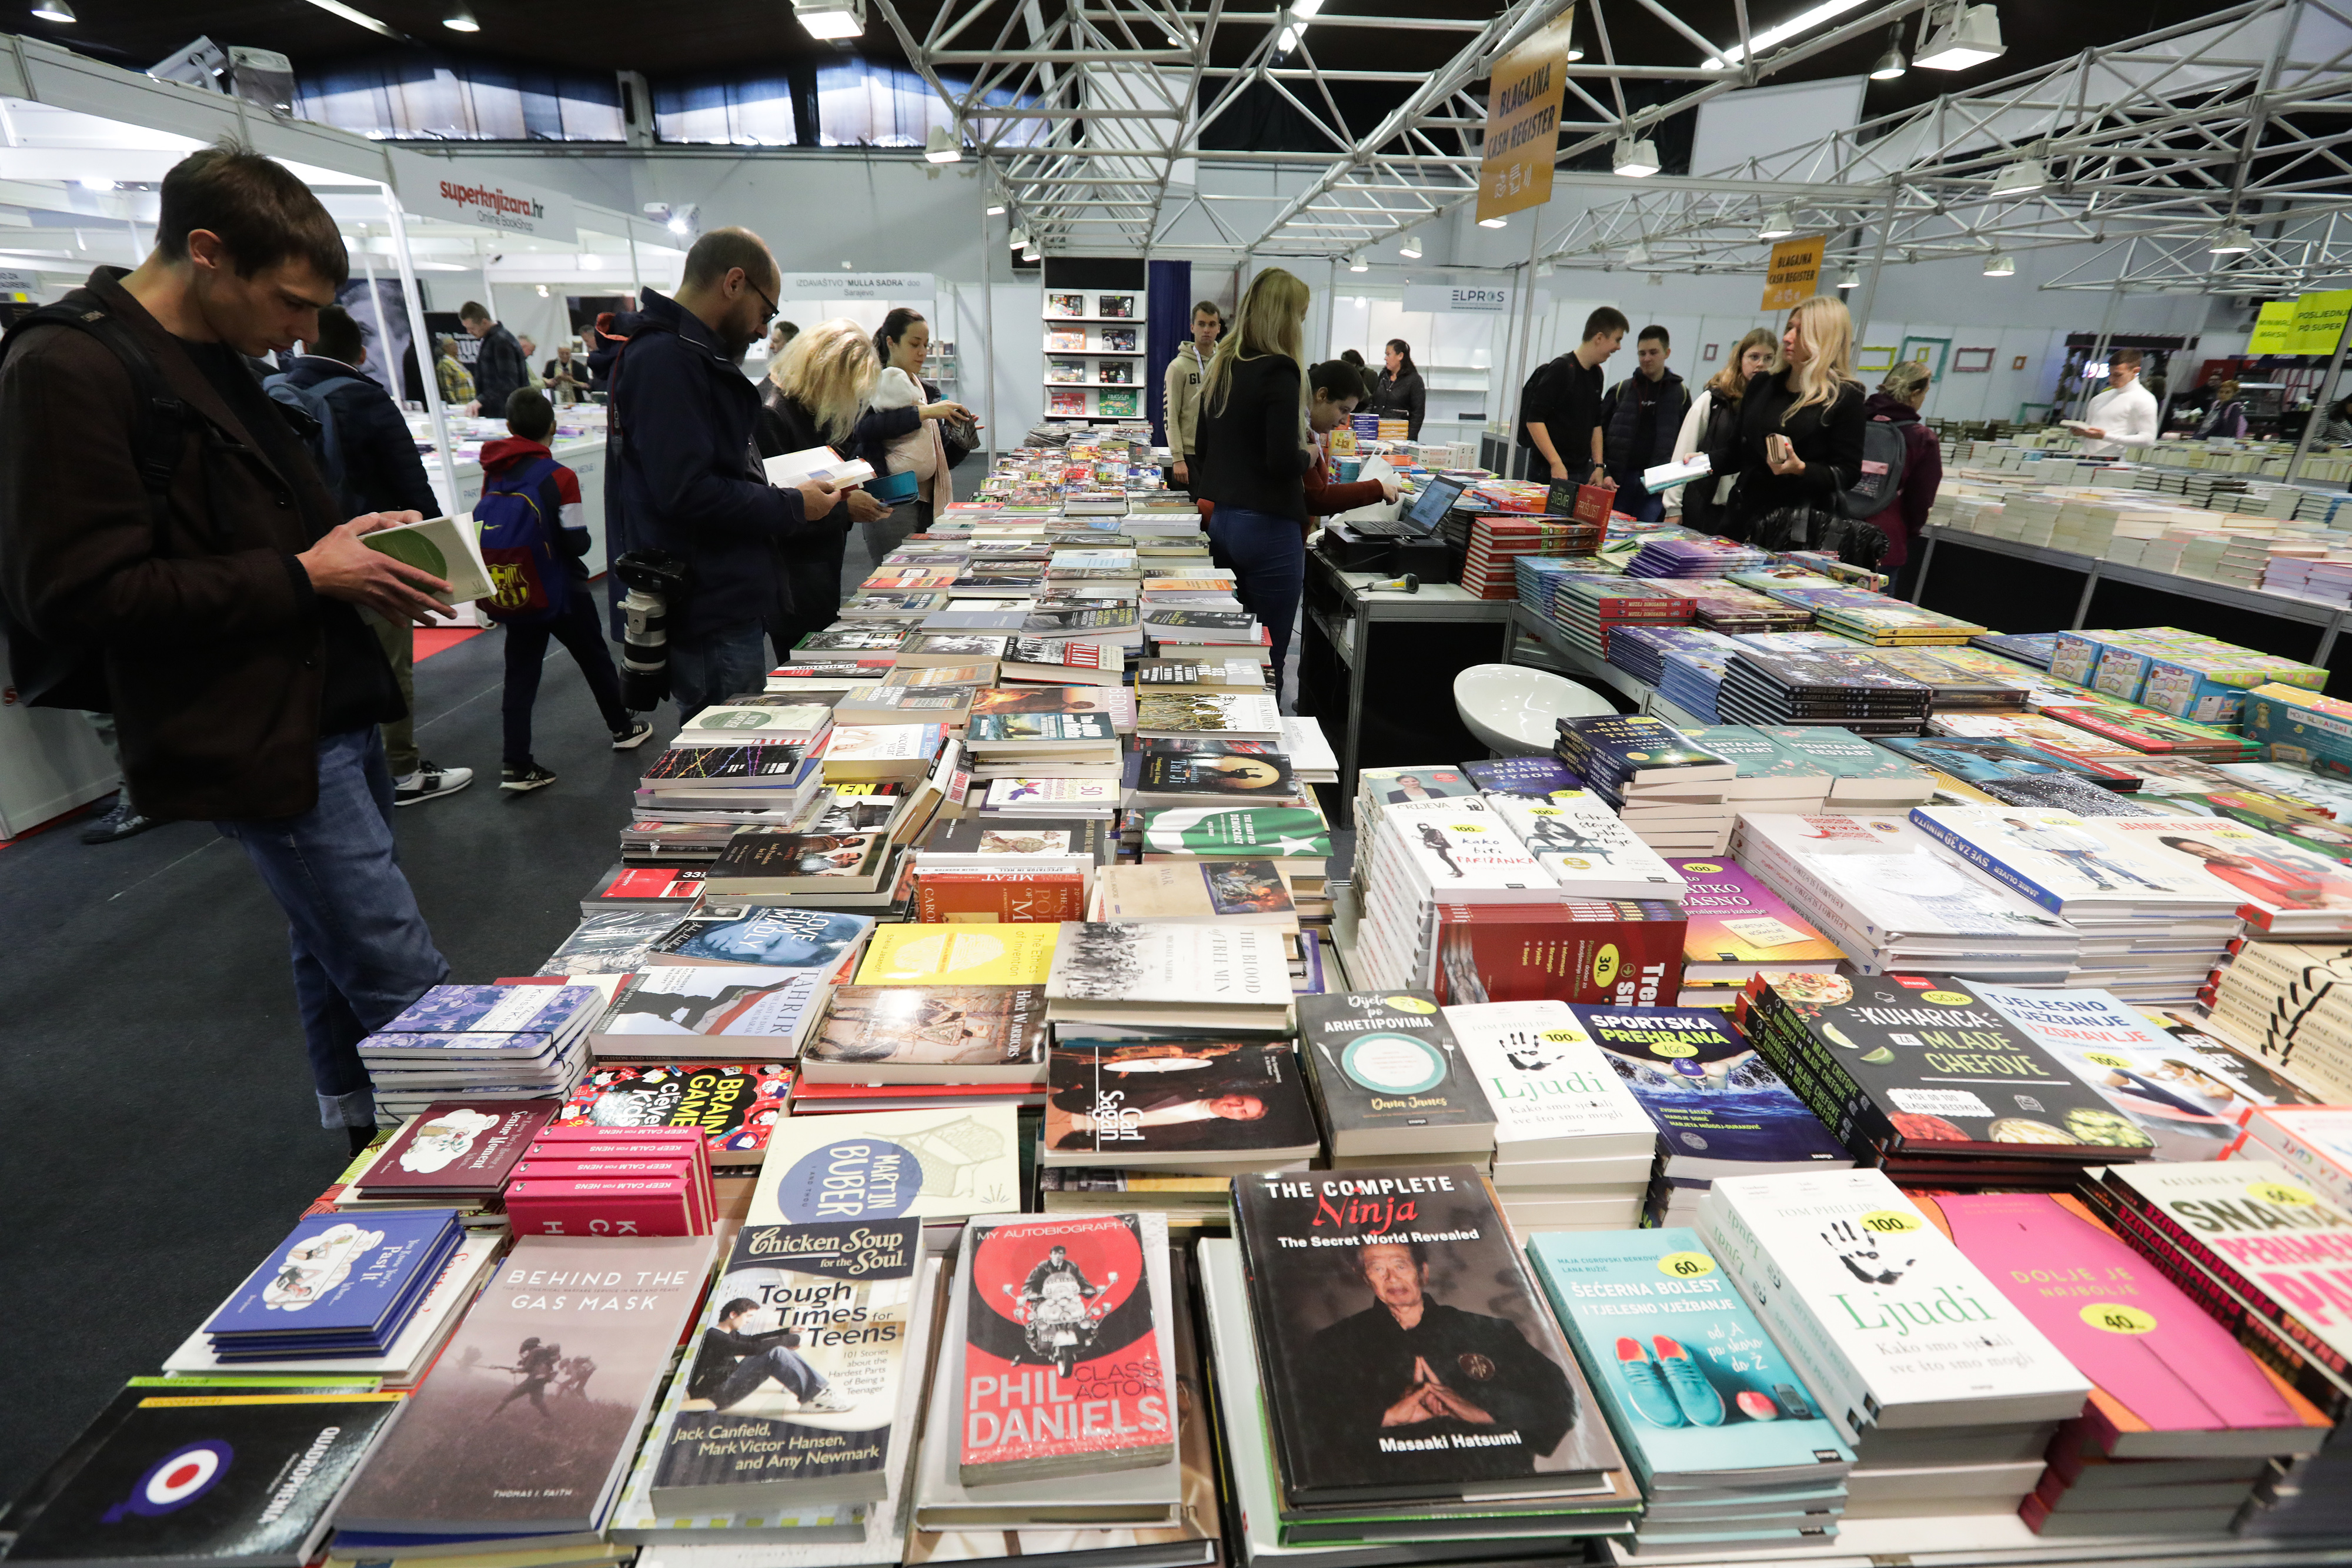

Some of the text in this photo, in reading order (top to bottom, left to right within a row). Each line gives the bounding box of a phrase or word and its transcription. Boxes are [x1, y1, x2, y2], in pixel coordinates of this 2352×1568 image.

[1499, 62, 1551, 118] BLAGAJNA
[1487, 104, 1556, 161] CASH REGISTER
[440, 180, 544, 219] superknjizara.hr
[477, 210, 533, 231] Online BookShop
[1778, 252, 1813, 268] BLAGAJNA
[797, 278, 843, 287] IZDAVAŠTVO
[1769, 270, 1815, 285] CASH REGISTER
[844, 289, 874, 297] Sarajevo
[2311, 323, 2342, 331] SUPER
[1071, 643, 1098, 666] POLAND
[1196, 664, 1212, 676] FIRE
[1212, 667, 1226, 676] SEE
[1224, 663, 1241, 674] WILL
[1239, 665, 1257, 674] YOU
[848, 687, 864, 699] WHEEN
[857, 687, 874, 701] FRANCIS
[867, 687, 885, 701] INDEED
[881, 687, 896, 697] DAYS
[886, 687, 906, 705] STRANGE
[1108, 688, 1129, 726] BEDOUIN
[1258, 697, 1272, 730] THE KHMERS
[1062, 714, 1081, 738] and Malta
[1080, 715, 1102, 737] The OHIO
[887, 743, 896, 755] year
[896, 733, 910, 757] second
[1790, 742, 1871, 750] MENTALNI
[1169, 760, 1188, 784] Tai Ji
[1080, 786, 1102, 795] 50
[1230, 814, 1244, 844] DEMOCRACY
[2117, 821, 2241, 832] JAMIE OLIVER
[1456, 854, 1536, 865] PARIŽANKA
[1160, 868, 1174, 885] WAR
[873, 934, 894, 972] Sheila Jasanoff
[1010, 931, 1024, 977] of Invention
[1029, 933, 1045, 974] The Ethics
[1208, 929, 1230, 992] of FREE MEN
[1546, 947, 1556, 973] Strategije
[1559, 947, 1568, 977] Informacije
[1598, 956, 1611, 972] 30
[769, 969, 822, 1034] TAHRIR
[1985, 992, 2109, 1012] TJELESNO
[1324, 1017, 1434, 1033] ARHETIPOVIMA
[1589, 1014, 1719, 1030] SPORTSKA
[2004, 1006, 2131, 1027] VJEŽBANJE
[1546, 1034, 1572, 1042] 100
[1598, 1028, 1732, 1044] PREHRANA
[1919, 1031, 2022, 1051] MLADE
[1924, 1052, 2051, 1076] CHEFOVE
[2089, 1056, 2122, 1067] 100
[1488, 1071, 1609, 1102] Ljudi
[700, 1079, 745, 1134] BRAIN
[1371, 1096, 1448, 1111] Dana James
[1092, 1090, 1125, 1141] Sagan
[1118, 1107, 1145, 1141] Carl
[816, 1145, 870, 1216] BUBER
[867, 1155, 901, 1209] MARTIN
[1265, 1176, 1455, 1199] THE COMPLETE
[977, 1216, 1137, 1241] MY AUTOBIOGRAPHY
[1867, 1218, 1905, 1231] 100
[749, 1226, 904, 1255] Chicken Soup
[1277, 1228, 1481, 1248] The Secret World Revealed
[820, 1258, 836, 1268] for
[836, 1258, 853, 1267] the
[507, 1269, 689, 1286] BEHIND THE
[2010, 1267, 2135, 1284] DOLJE JE
[759, 1281, 851, 1308] Tough
[1571, 1278, 1722, 1298] ŠEĆERNA BOLEST
[2039, 1284, 2140, 1298] NAJBOLJE
[511, 1295, 659, 1311] GAS MASK
[1582, 1299, 1736, 1316] I TJELESNO VJEŽBANJE
[775, 1306, 893, 1326] Times for
[2104, 1315, 2134, 1329] 40
[808, 1326, 897, 1348] Teens
[843, 1349, 889, 1359] 101 Stories
[846, 1359, 872, 1368] about
[1074, 1362, 1160, 1382] CLASS
[846, 1385, 886, 1396] Teenager
[969, 1370, 1074, 1411] PHIL
[1074, 1379, 1162, 1400] ACTOR
[968, 1396, 1167, 1449] DANIELS
[671, 1422, 771, 1445] Jack Canfield,
[1378, 1430, 1522, 1453] Masaaki Hatsumi
[698, 1435, 847, 1457] Mark Victor Hansen,
[735, 1445, 880, 1471] and Amy Newmark
[258, 1426, 340, 1524] QUADROPHENIA
